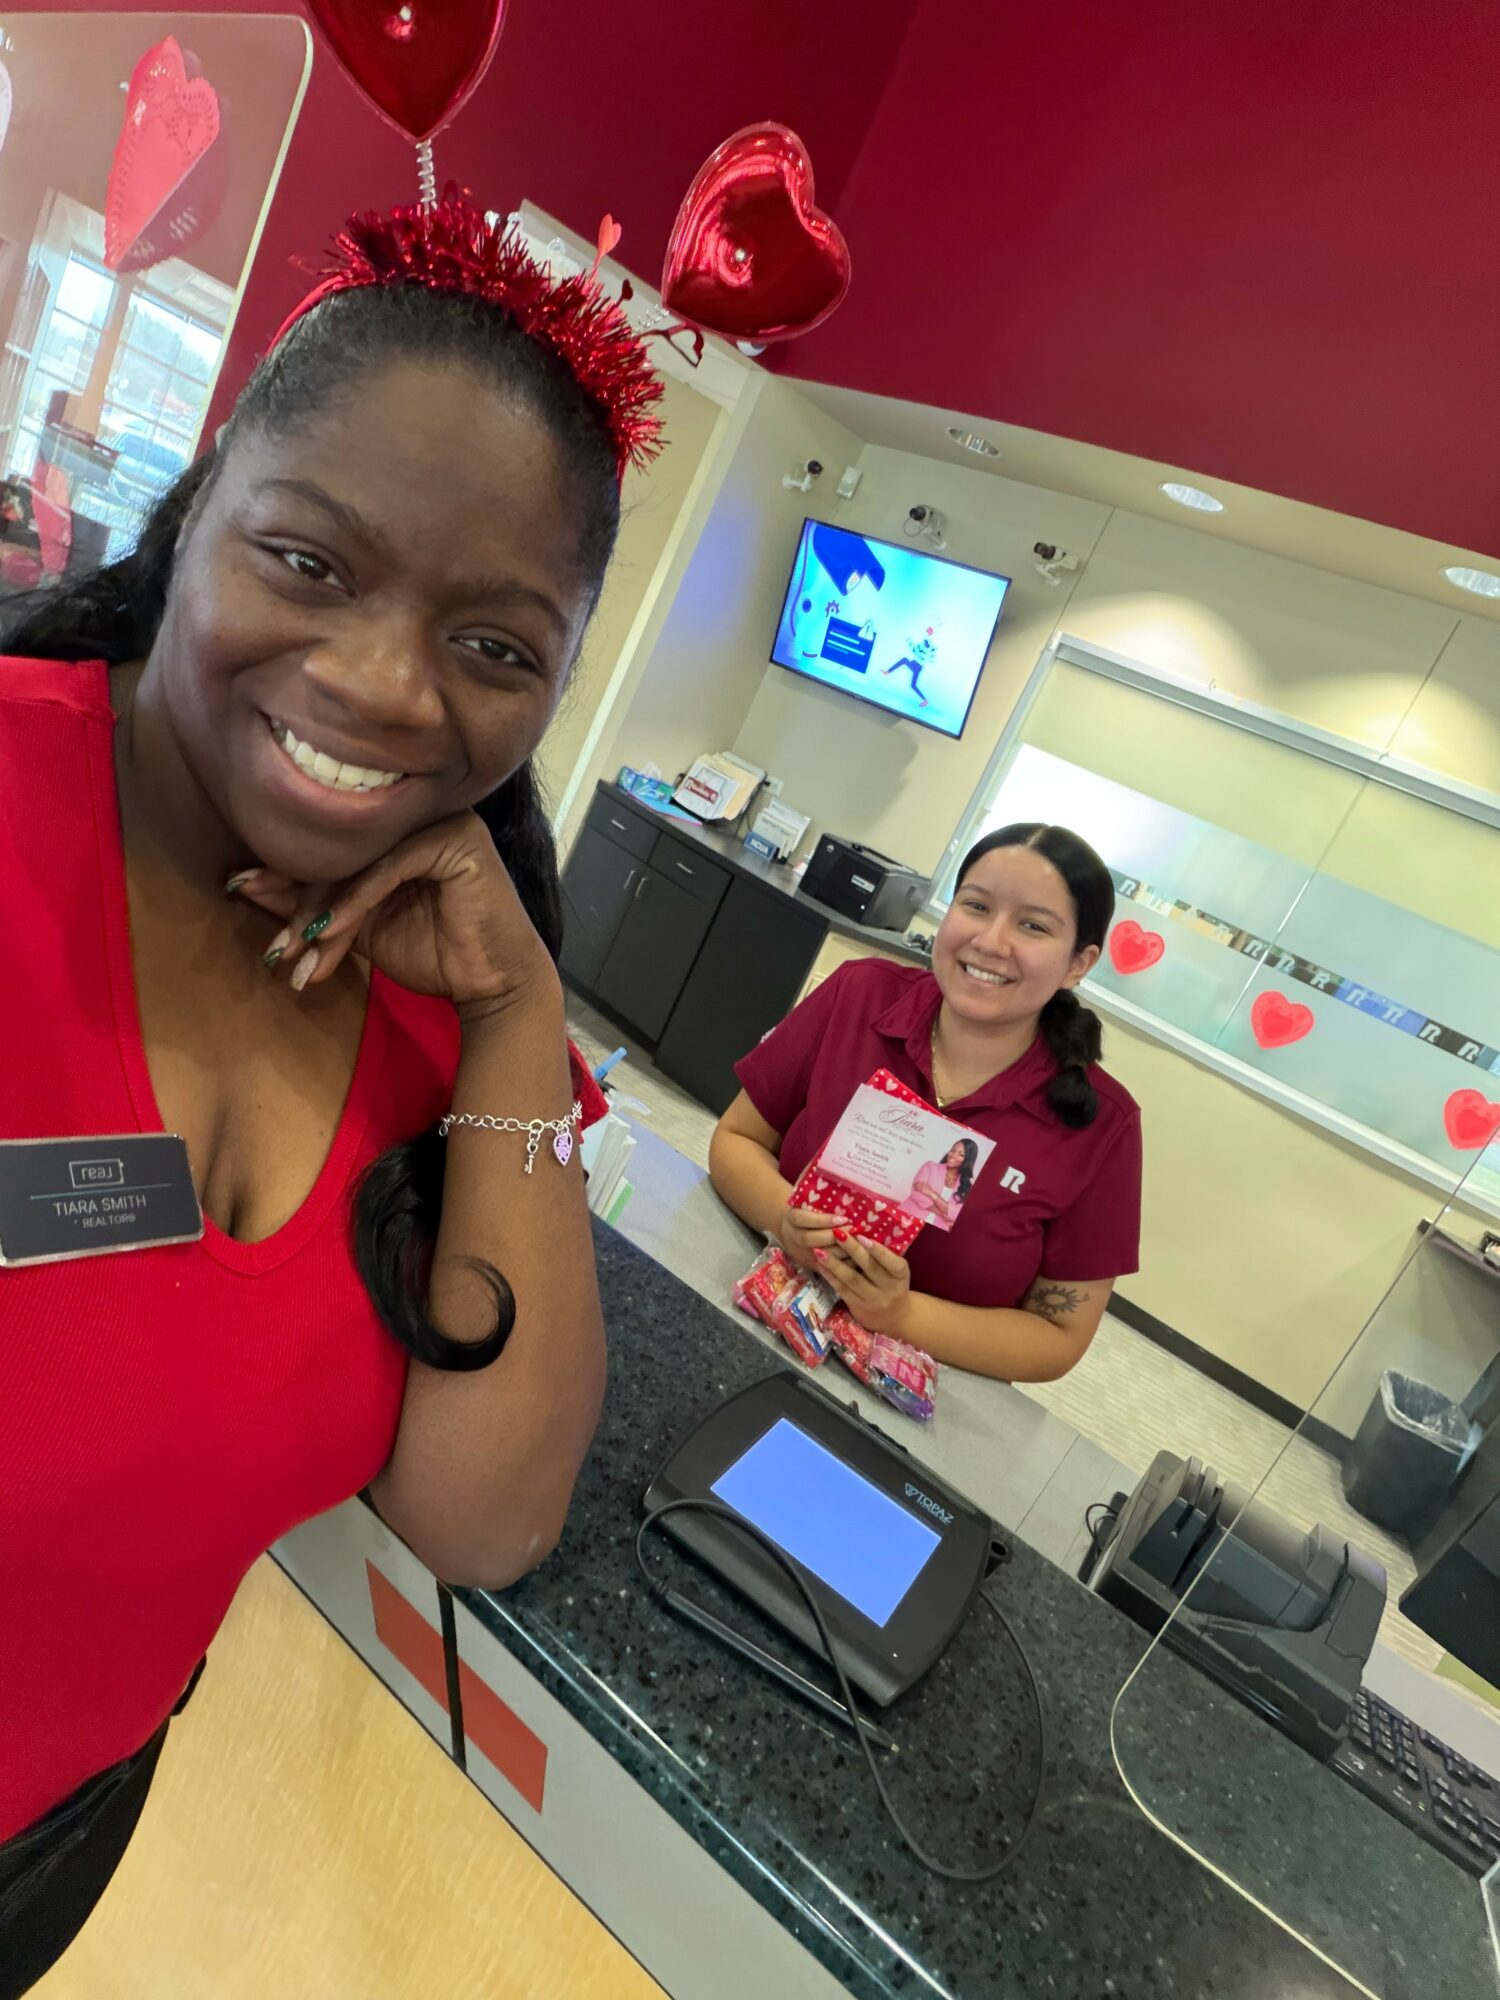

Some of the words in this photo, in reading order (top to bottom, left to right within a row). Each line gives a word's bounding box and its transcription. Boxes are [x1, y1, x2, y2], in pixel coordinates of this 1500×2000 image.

[53, 1199, 98, 1217] TIARA
[101, 1194, 147, 1212] SMITH
[917, 1491, 955, 1523] TOPAZ
